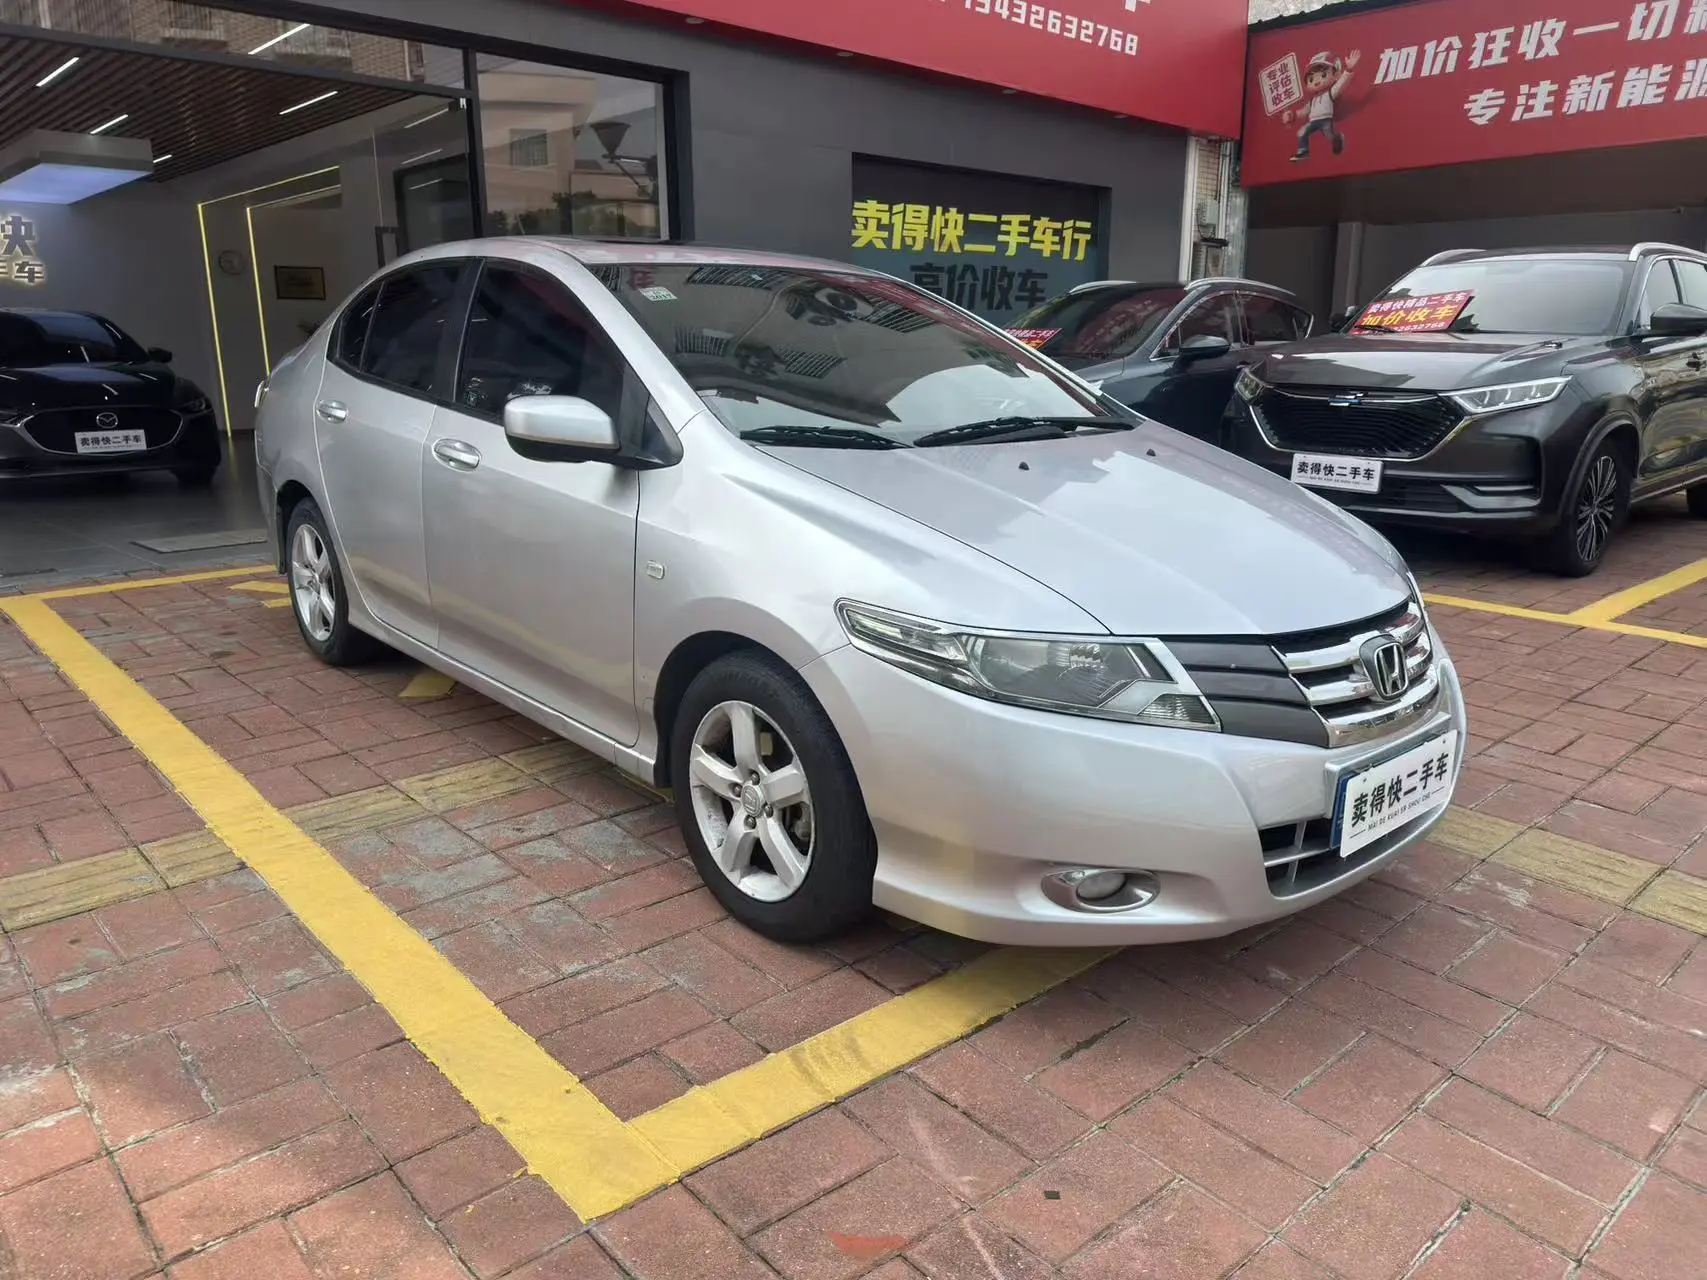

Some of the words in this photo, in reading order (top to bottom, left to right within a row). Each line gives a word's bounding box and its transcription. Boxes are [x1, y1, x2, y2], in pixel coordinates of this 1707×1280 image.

[851, 200, 1092, 261] 卖得快二手车行
[0, 260, 45, 283] 车
[910, 263, 1048, 312] 高价收车
[1368, 292, 1467, 313] 卖得快精品二手车
[1362, 305, 1458, 326] 加价收车
[1297, 461, 1375, 481] 卖得快二手车
[1351, 752, 1449, 828] 卖得快二手车
